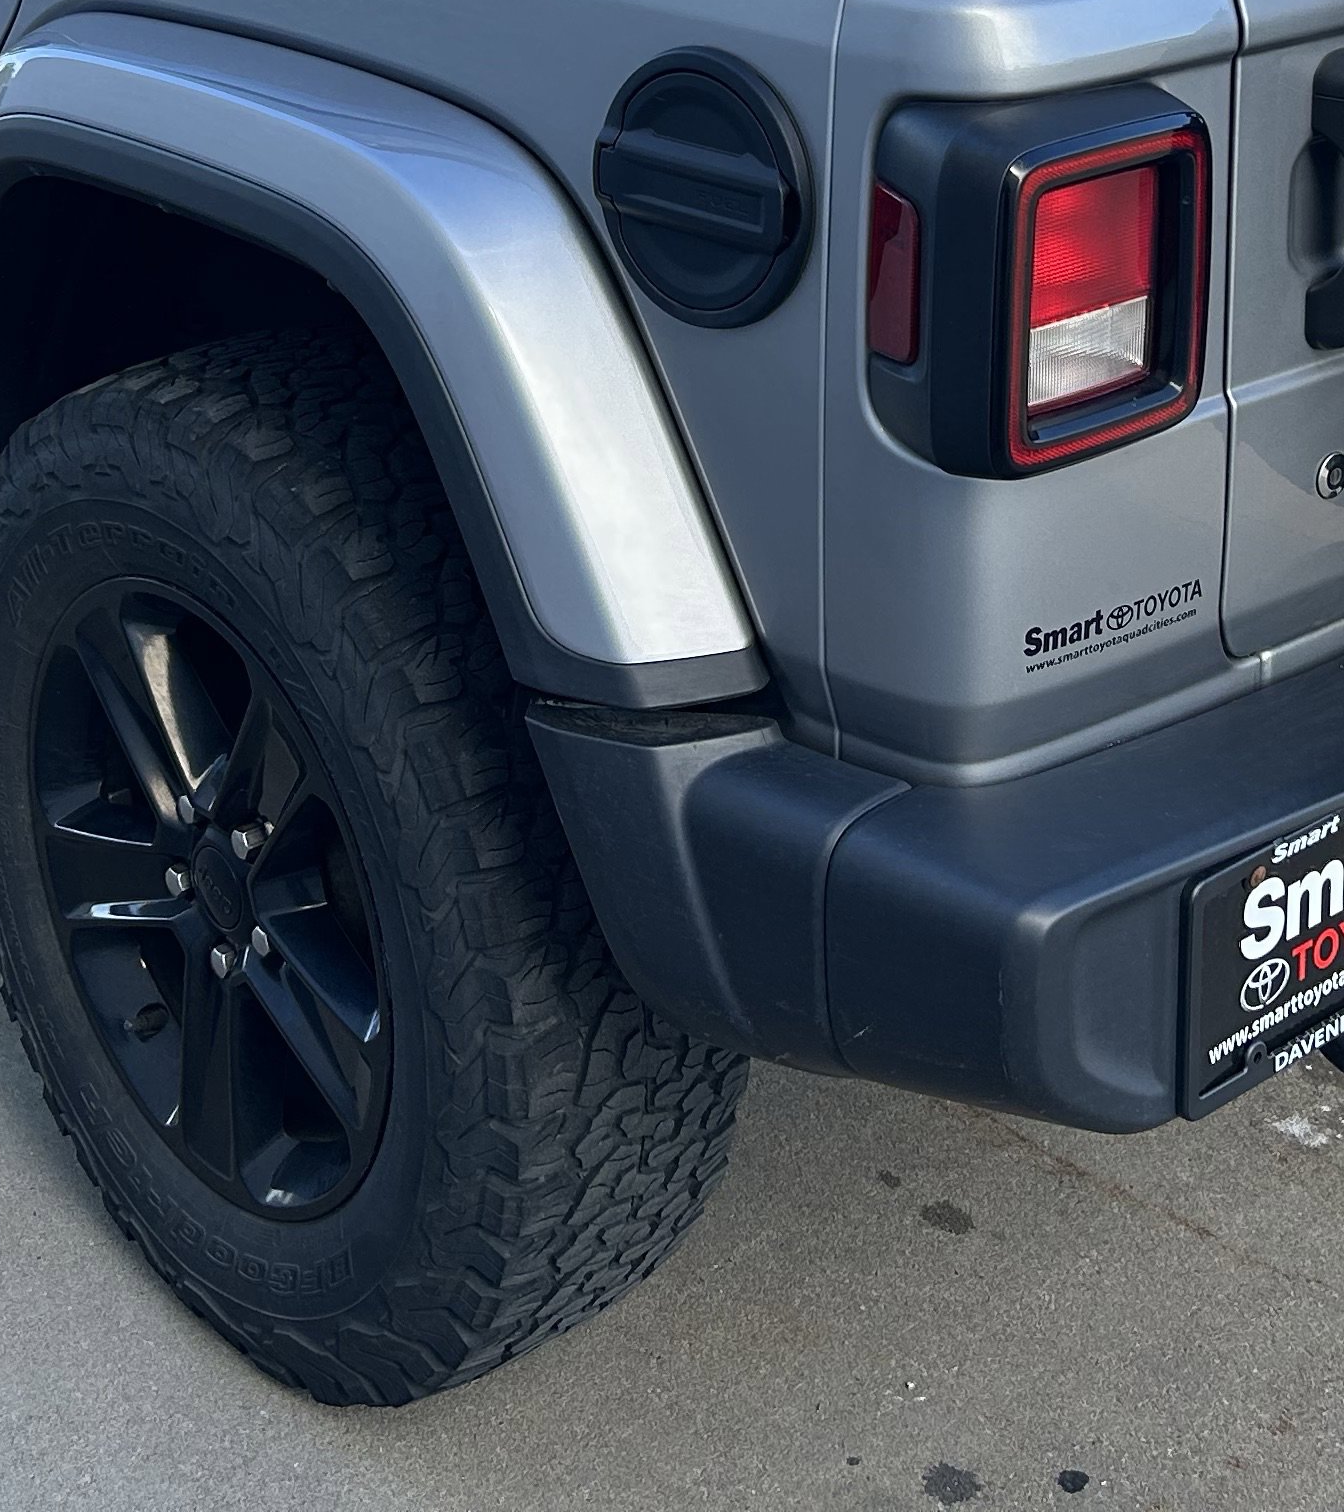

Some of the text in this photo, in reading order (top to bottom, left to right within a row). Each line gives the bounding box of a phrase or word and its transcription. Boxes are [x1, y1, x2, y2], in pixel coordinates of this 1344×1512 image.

[1023, 578, 1202, 657] Smart TOYOTA
[1025, 607, 1197, 674] www.smarttoyotaquadcities.com
[1271, 813, 1341, 865] Smart
